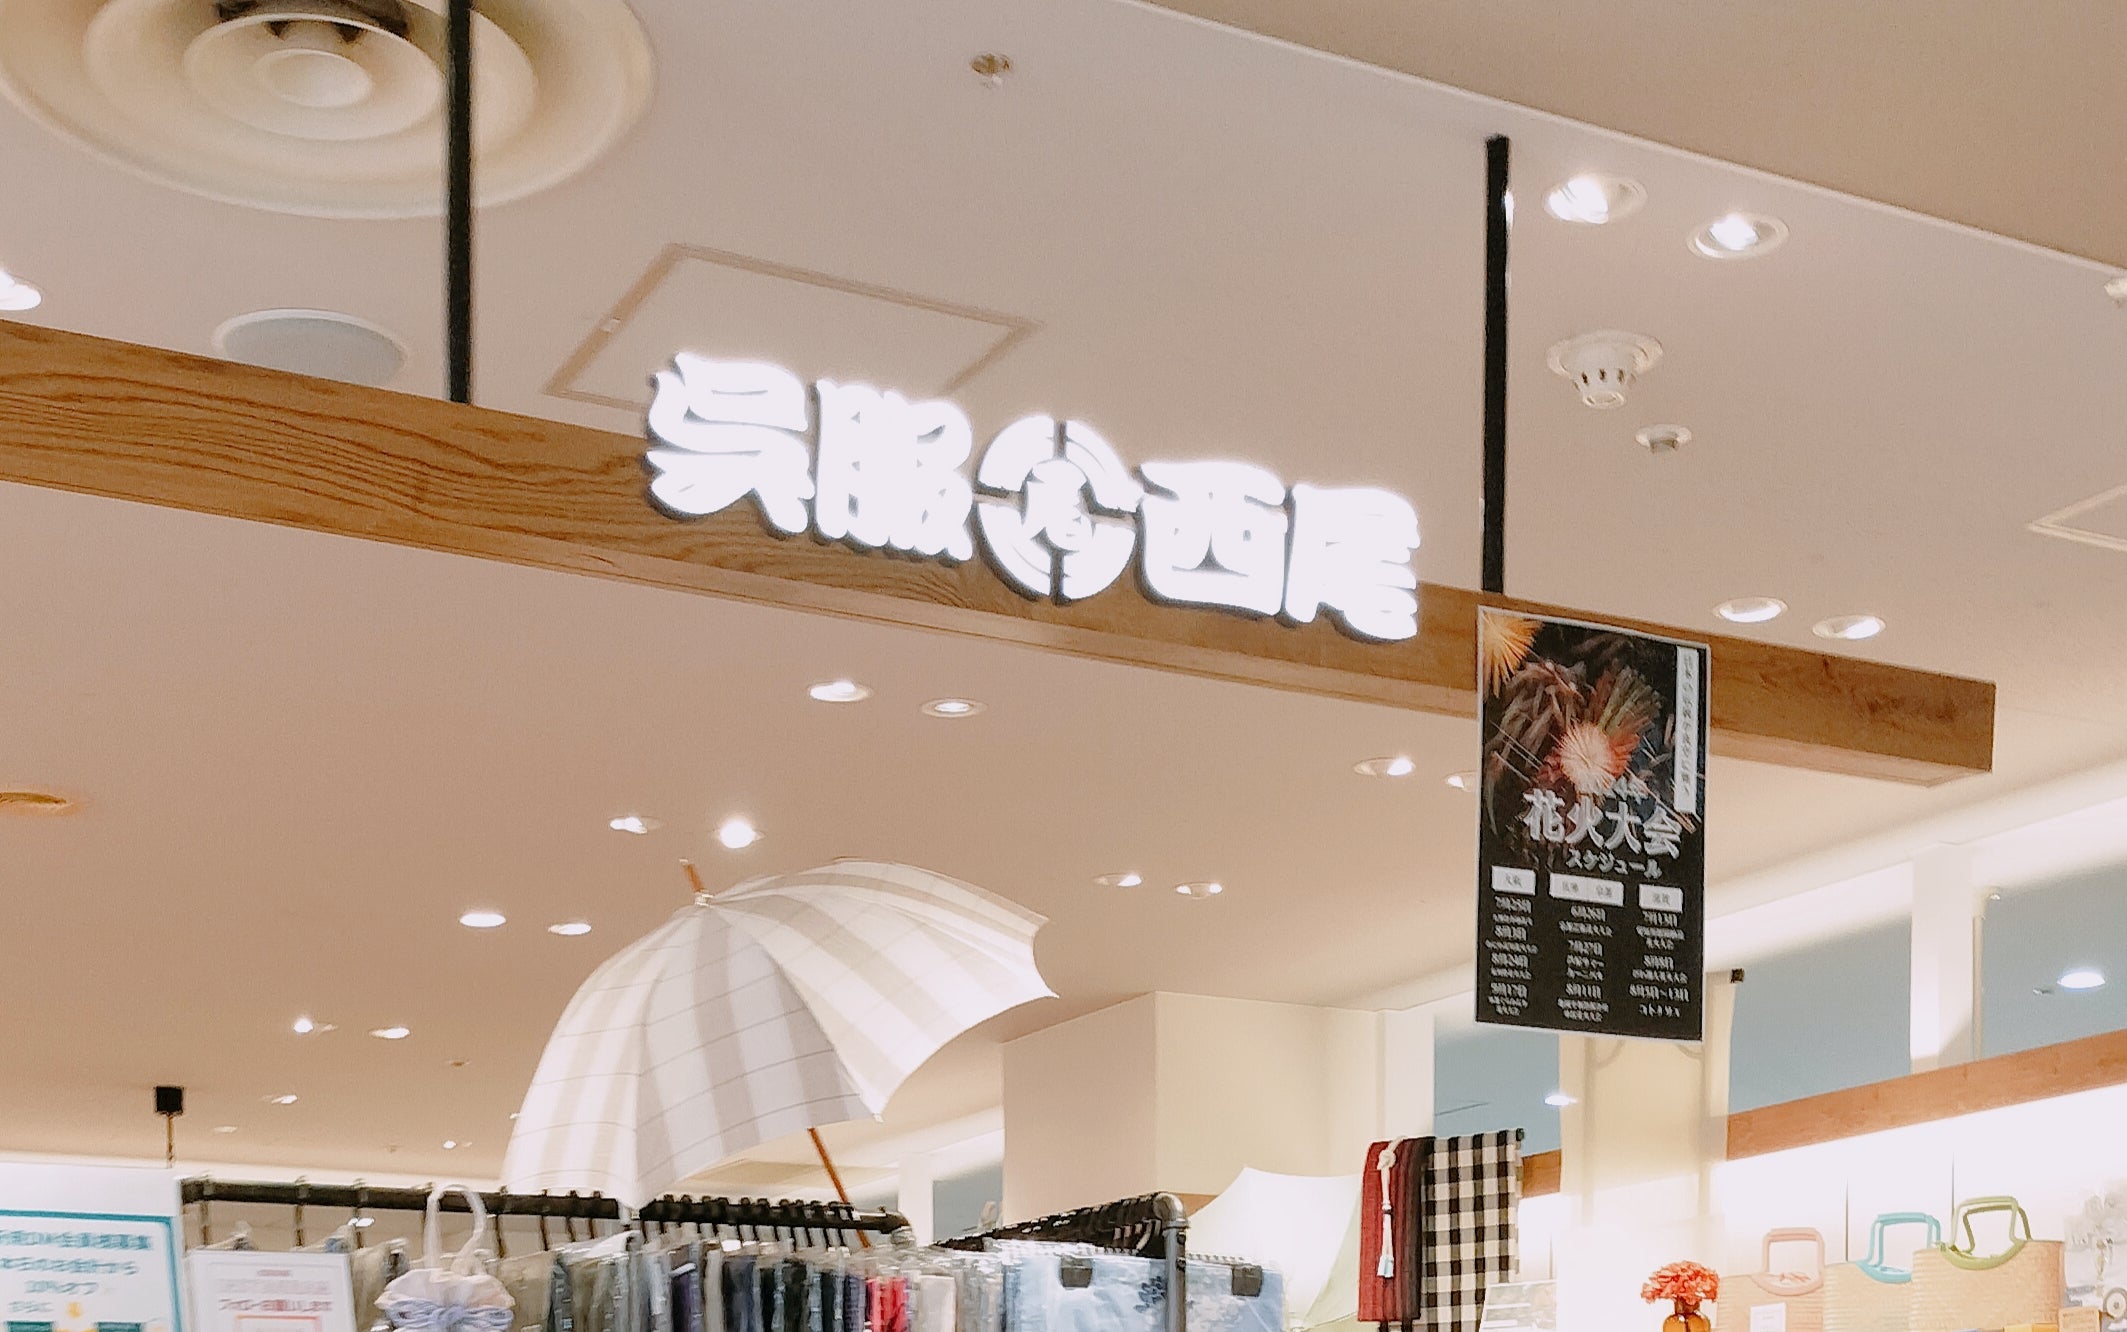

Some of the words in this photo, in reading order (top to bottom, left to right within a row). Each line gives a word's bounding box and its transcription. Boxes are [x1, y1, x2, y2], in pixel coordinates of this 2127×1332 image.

[648, 352, 972, 562] 呉服
[1140, 461, 1420, 641] 西尾
[1523, 788, 1683, 860] 花火大会
[1565, 849, 1663, 880] スケジュール
